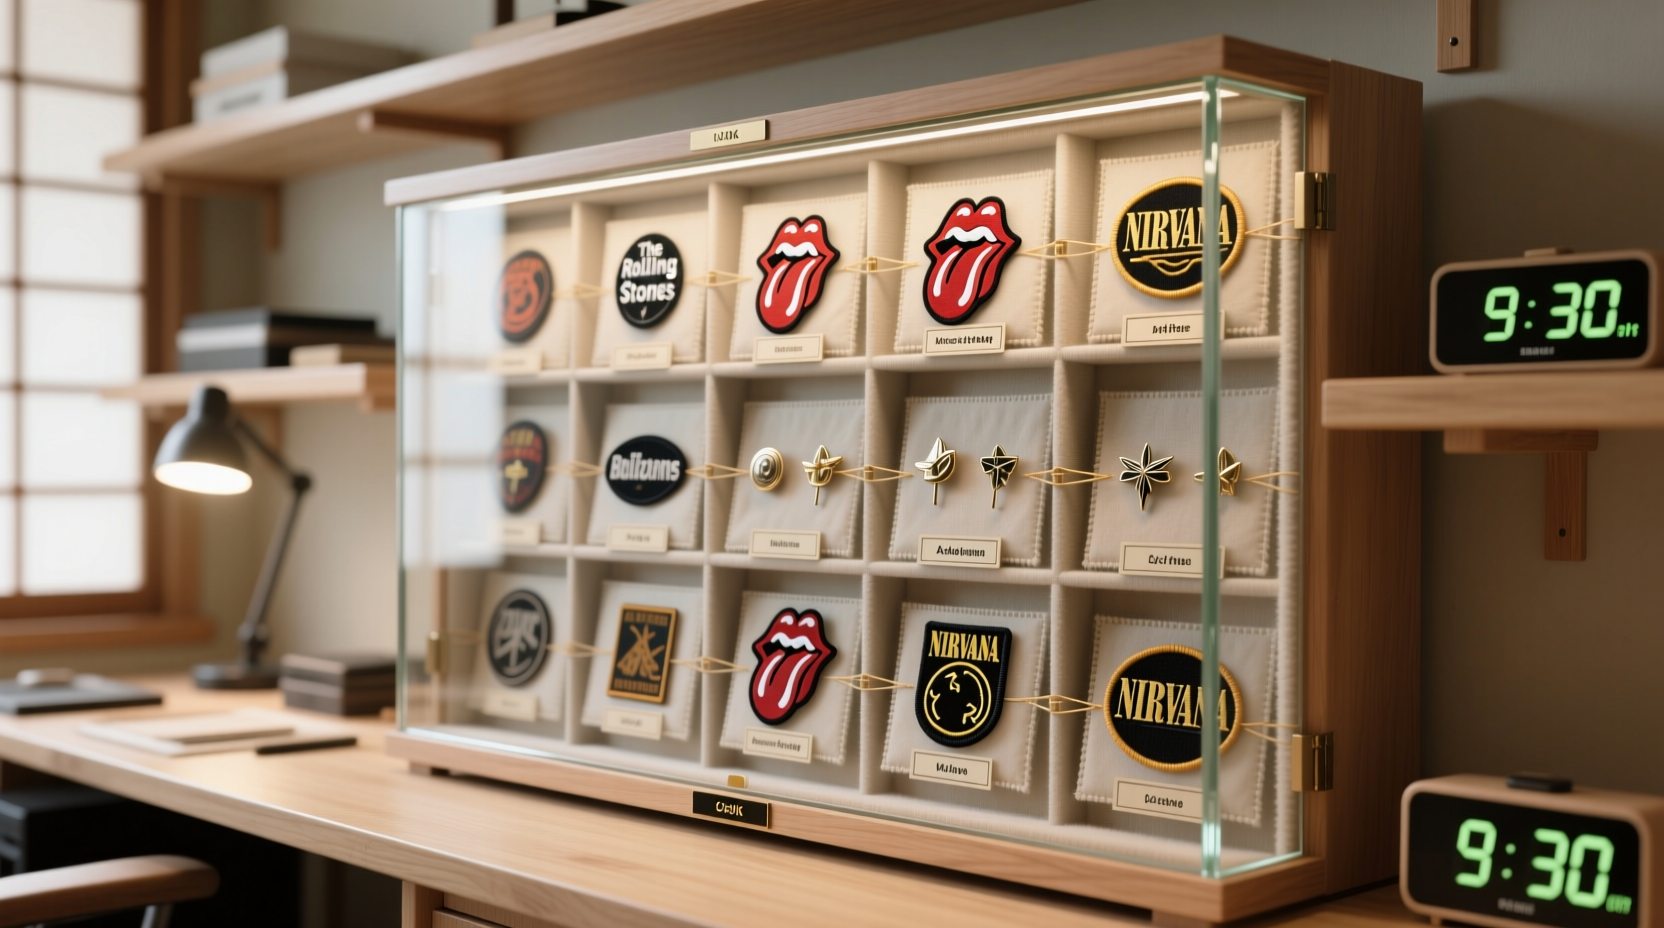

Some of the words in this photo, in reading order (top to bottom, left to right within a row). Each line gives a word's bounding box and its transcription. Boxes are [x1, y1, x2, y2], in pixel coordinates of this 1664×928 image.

[637, 240, 664, 257] The
[620, 256, 678, 280] Rolling
[619, 280, 676, 304] Stones
[1483, 279, 1622, 342] 9:30
[928, 630, 1000, 663] NIRVANA
[1455, 818, 1614, 909] 9:30
